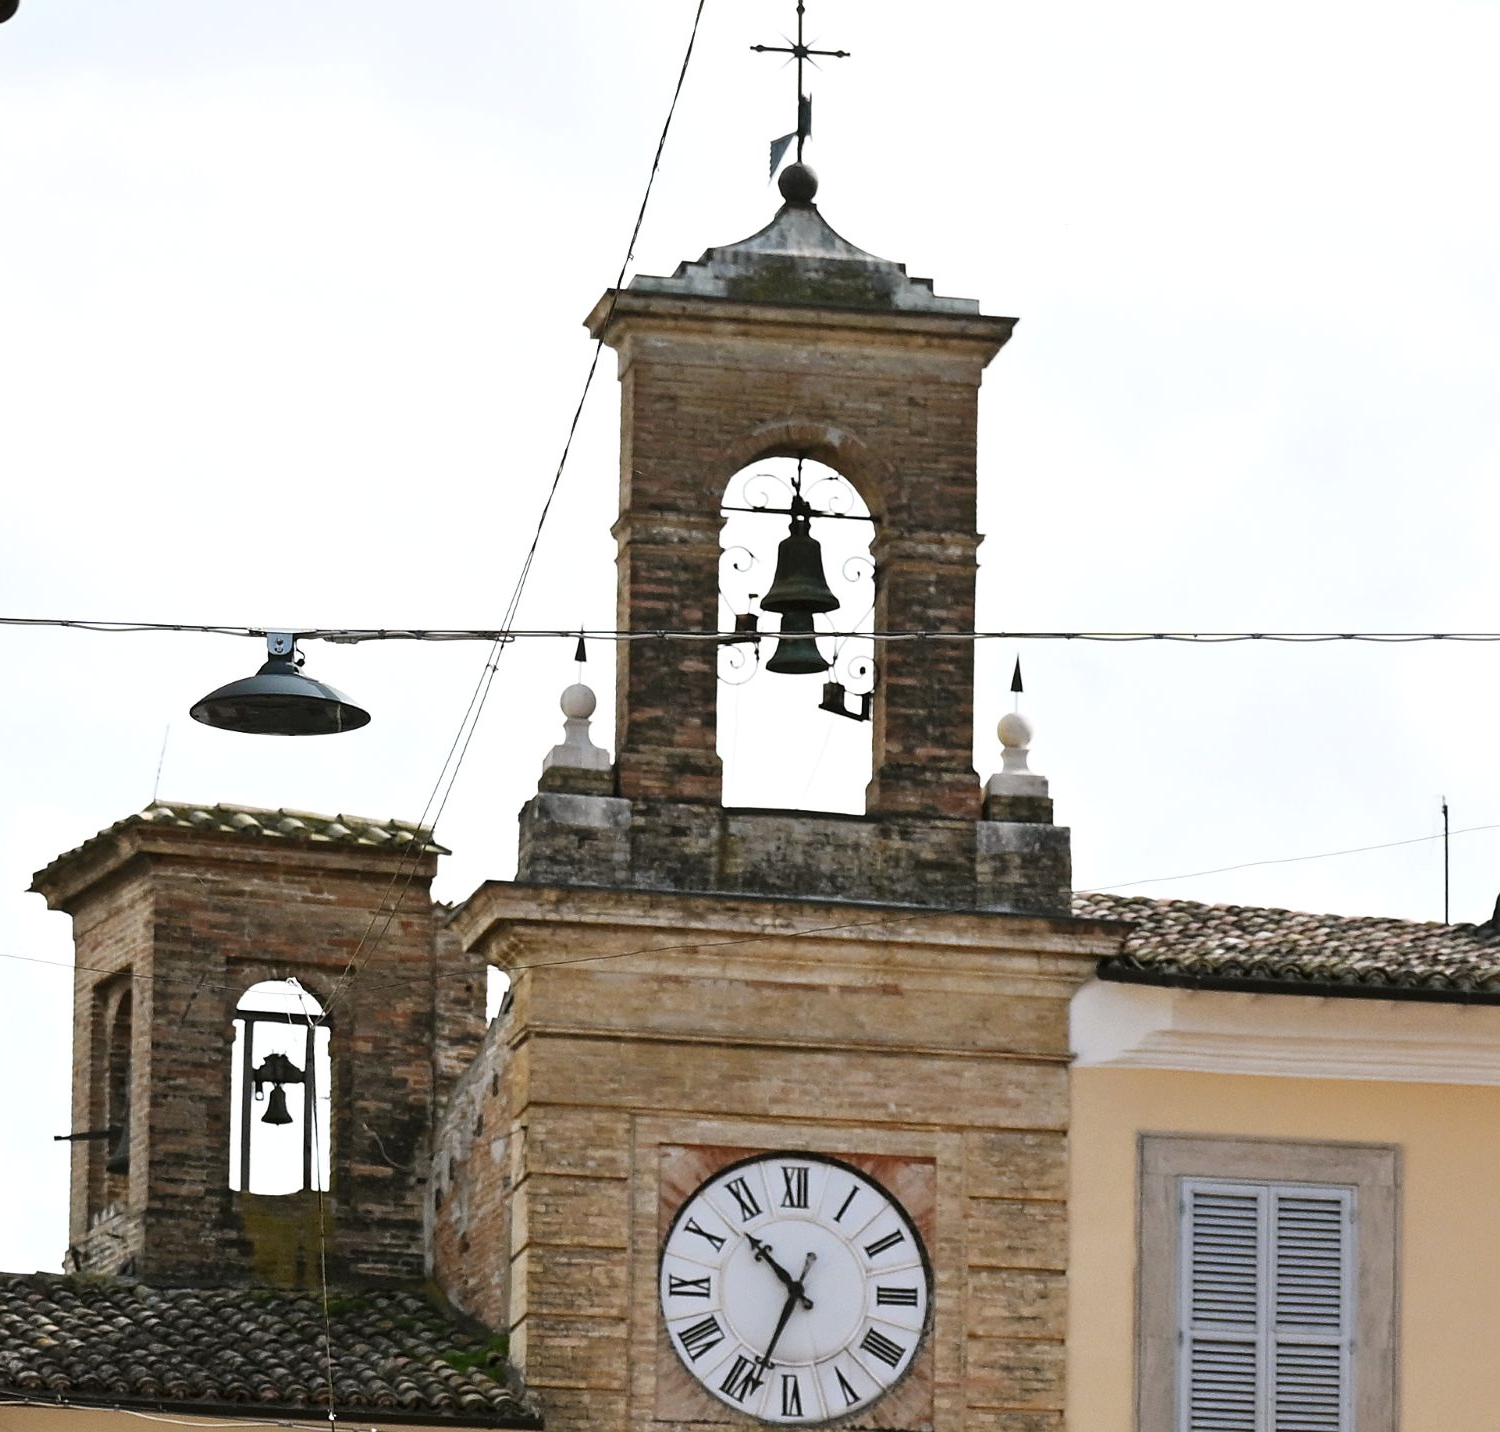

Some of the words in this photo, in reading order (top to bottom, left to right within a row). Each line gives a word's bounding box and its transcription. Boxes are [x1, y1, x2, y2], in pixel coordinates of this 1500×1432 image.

[724, 1177, 763, 1222] XI
[781, 1167, 809, 1208] XII
[684, 1217, 726, 1253] X
